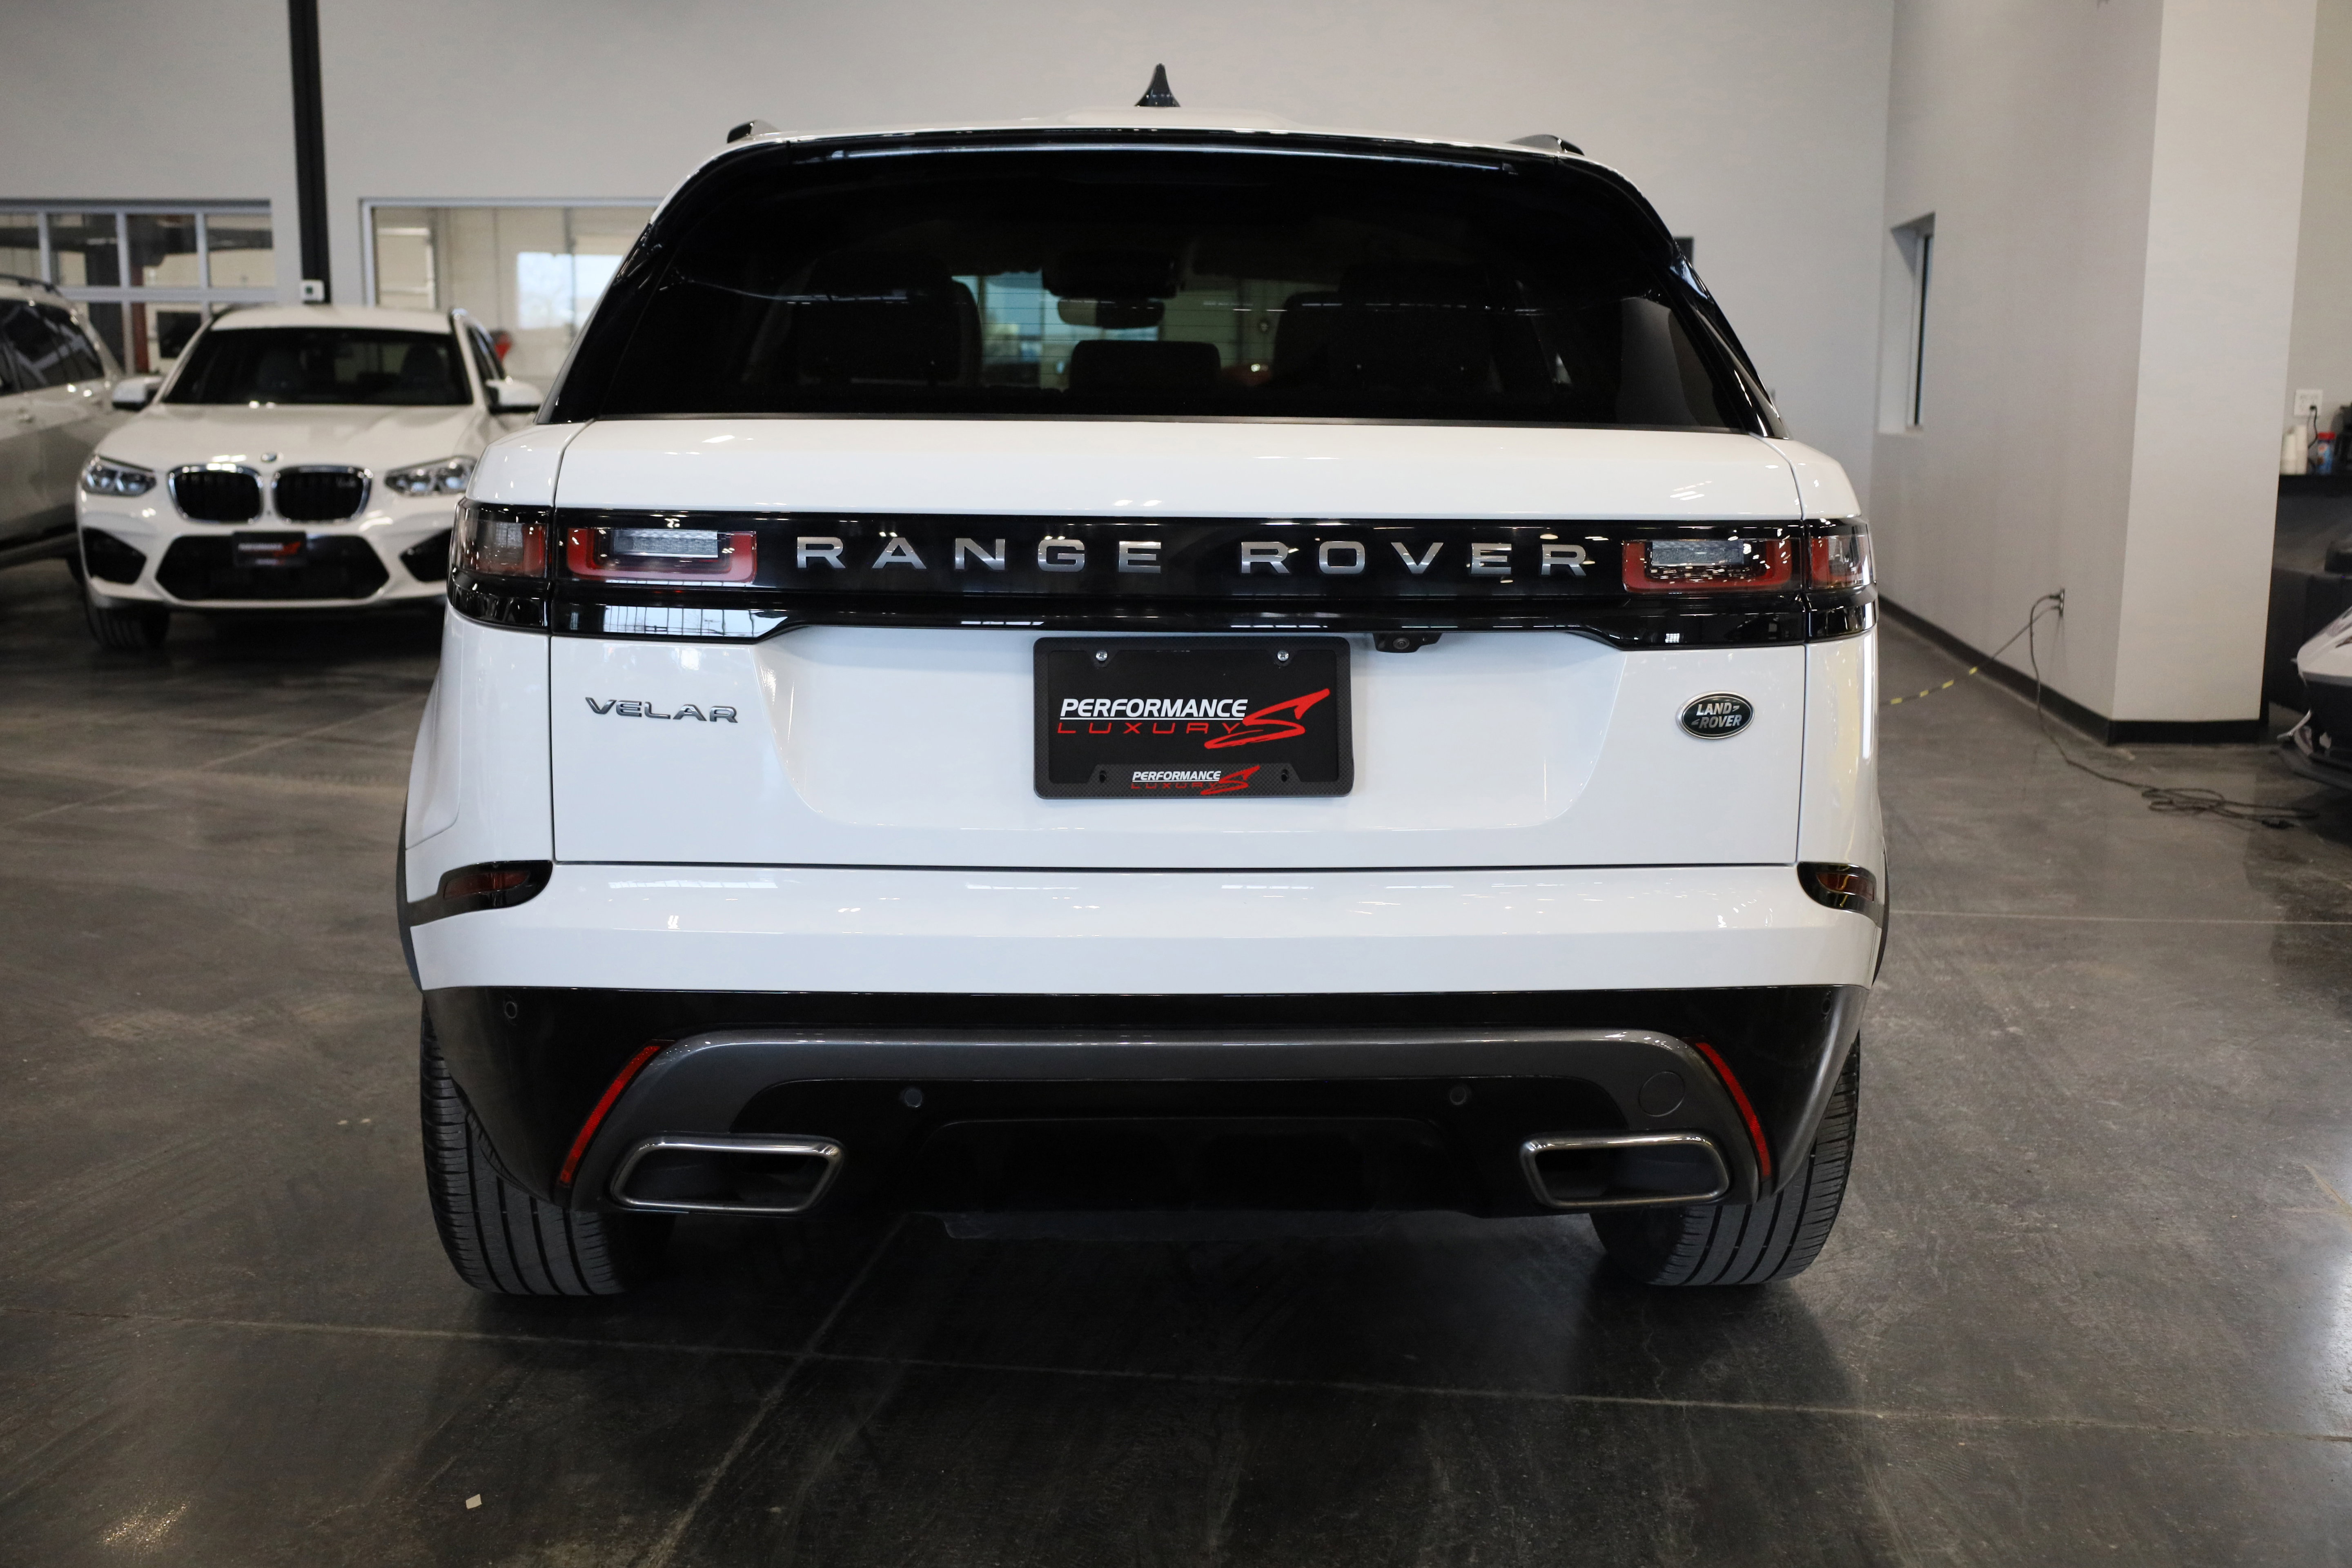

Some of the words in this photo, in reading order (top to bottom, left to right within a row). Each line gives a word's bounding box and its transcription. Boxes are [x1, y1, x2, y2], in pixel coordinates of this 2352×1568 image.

[797, 536, 1161, 572] RANGE
[1241, 541, 1587, 575] ROVER
[585, 697, 738, 724] VELAR
[1060, 698, 1248, 717] PERFORMANCE
[1696, 702, 1732, 716] LAND
[1057, 722, 1240, 734] LUXURY
[1699, 715, 1742, 728] ROVER
[1132, 771, 1221, 781] PERFORMANCE
